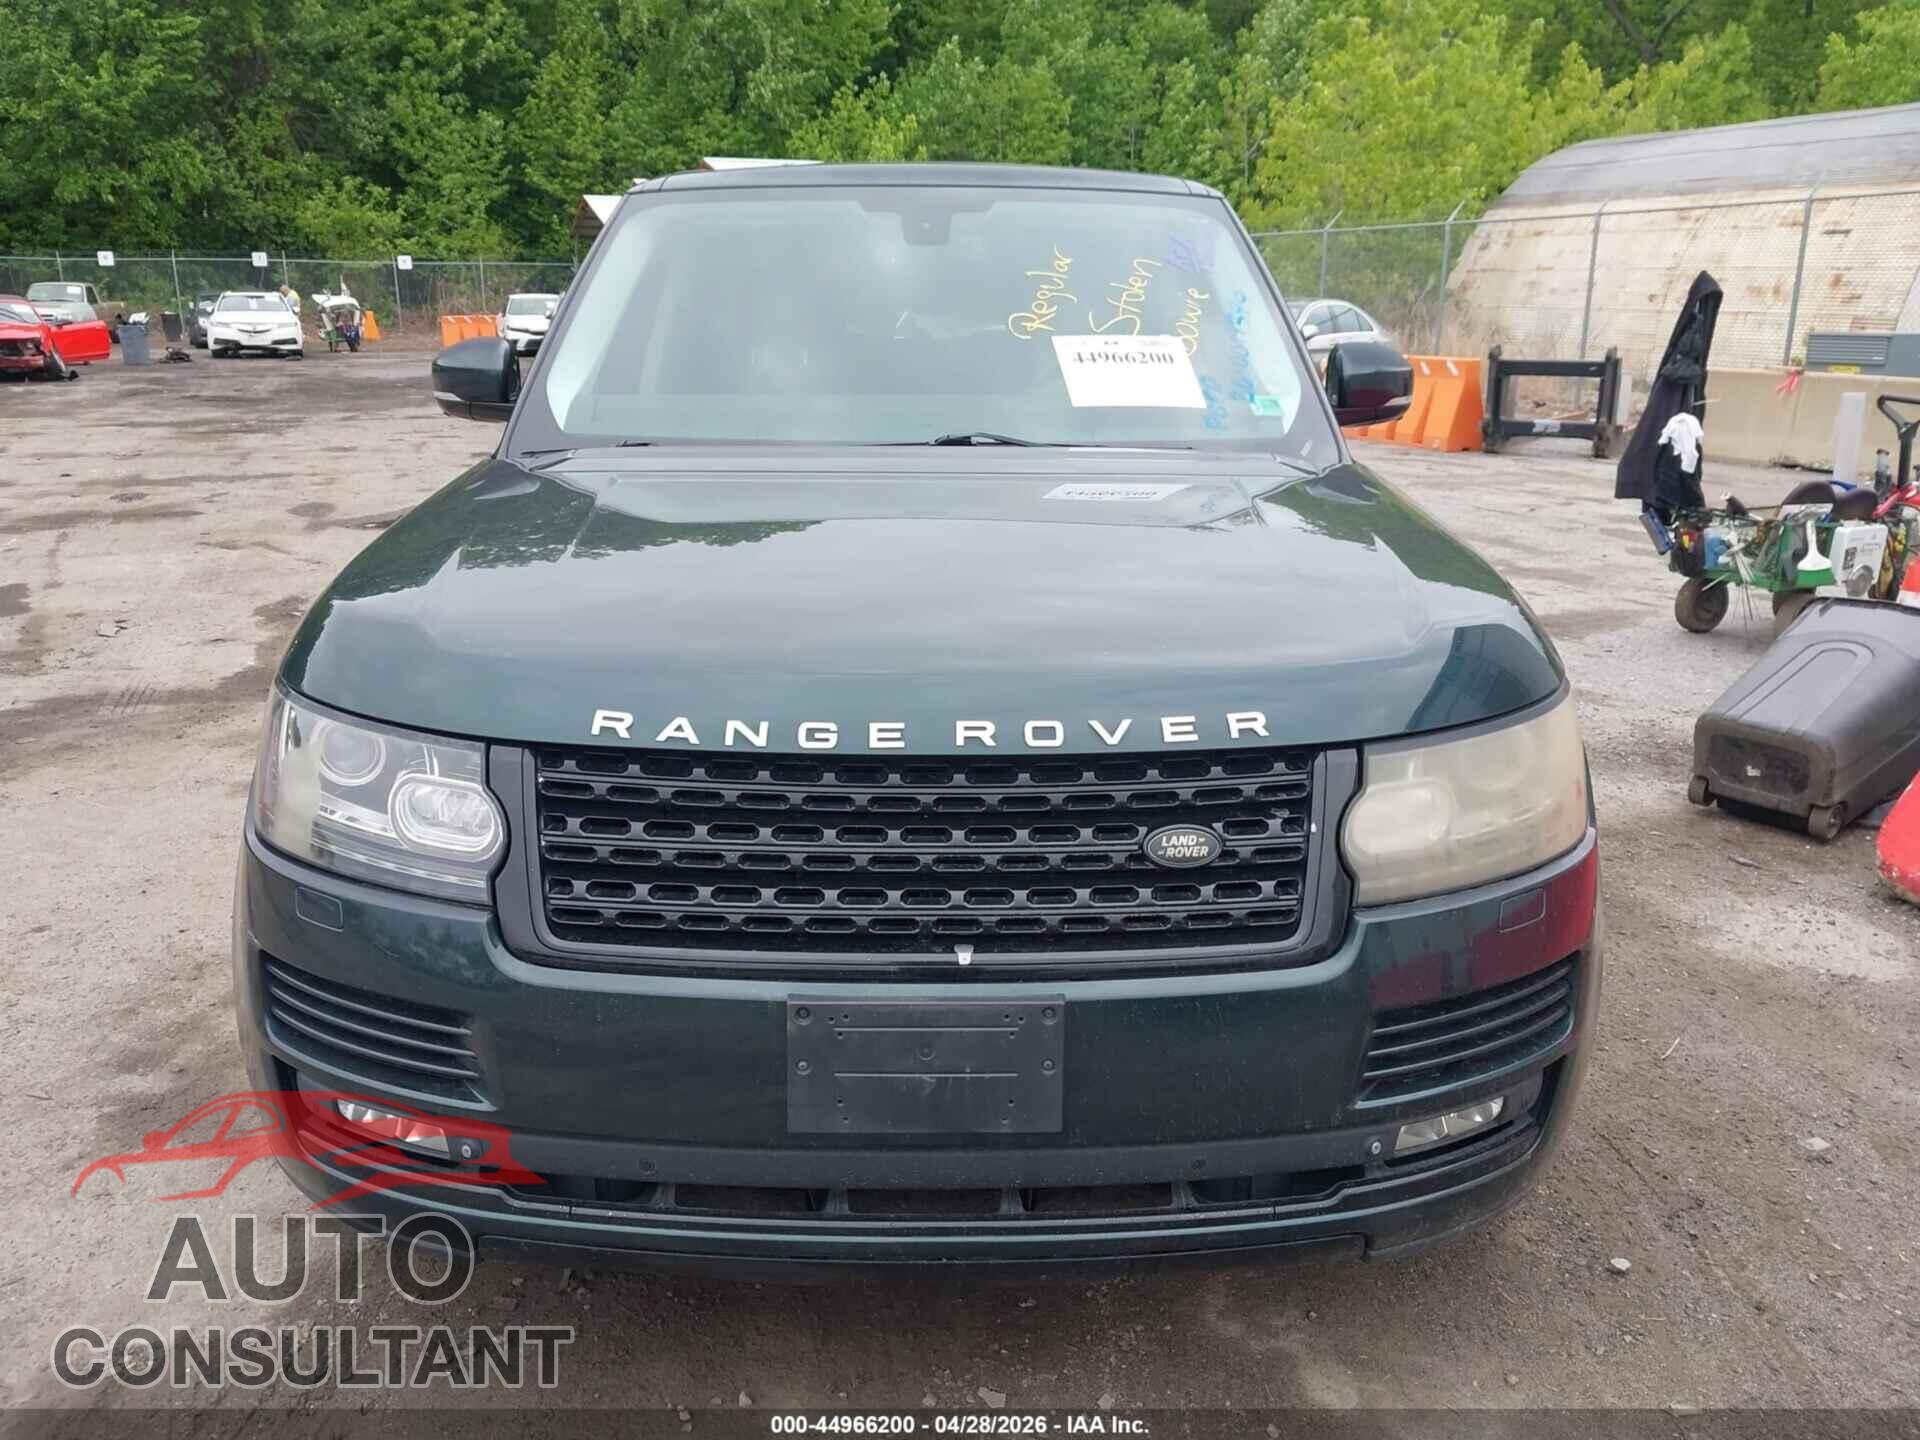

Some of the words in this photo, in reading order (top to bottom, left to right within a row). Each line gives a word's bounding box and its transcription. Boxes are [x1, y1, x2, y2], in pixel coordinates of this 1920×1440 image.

[1008, 244, 1077, 340] Regular
[1089, 258, 1163, 336] Stolen
[1073, 351, 1174, 364] 44966200
[591, 709, 906, 750] RANGE
[954, 710, 1270, 748] ROVER
